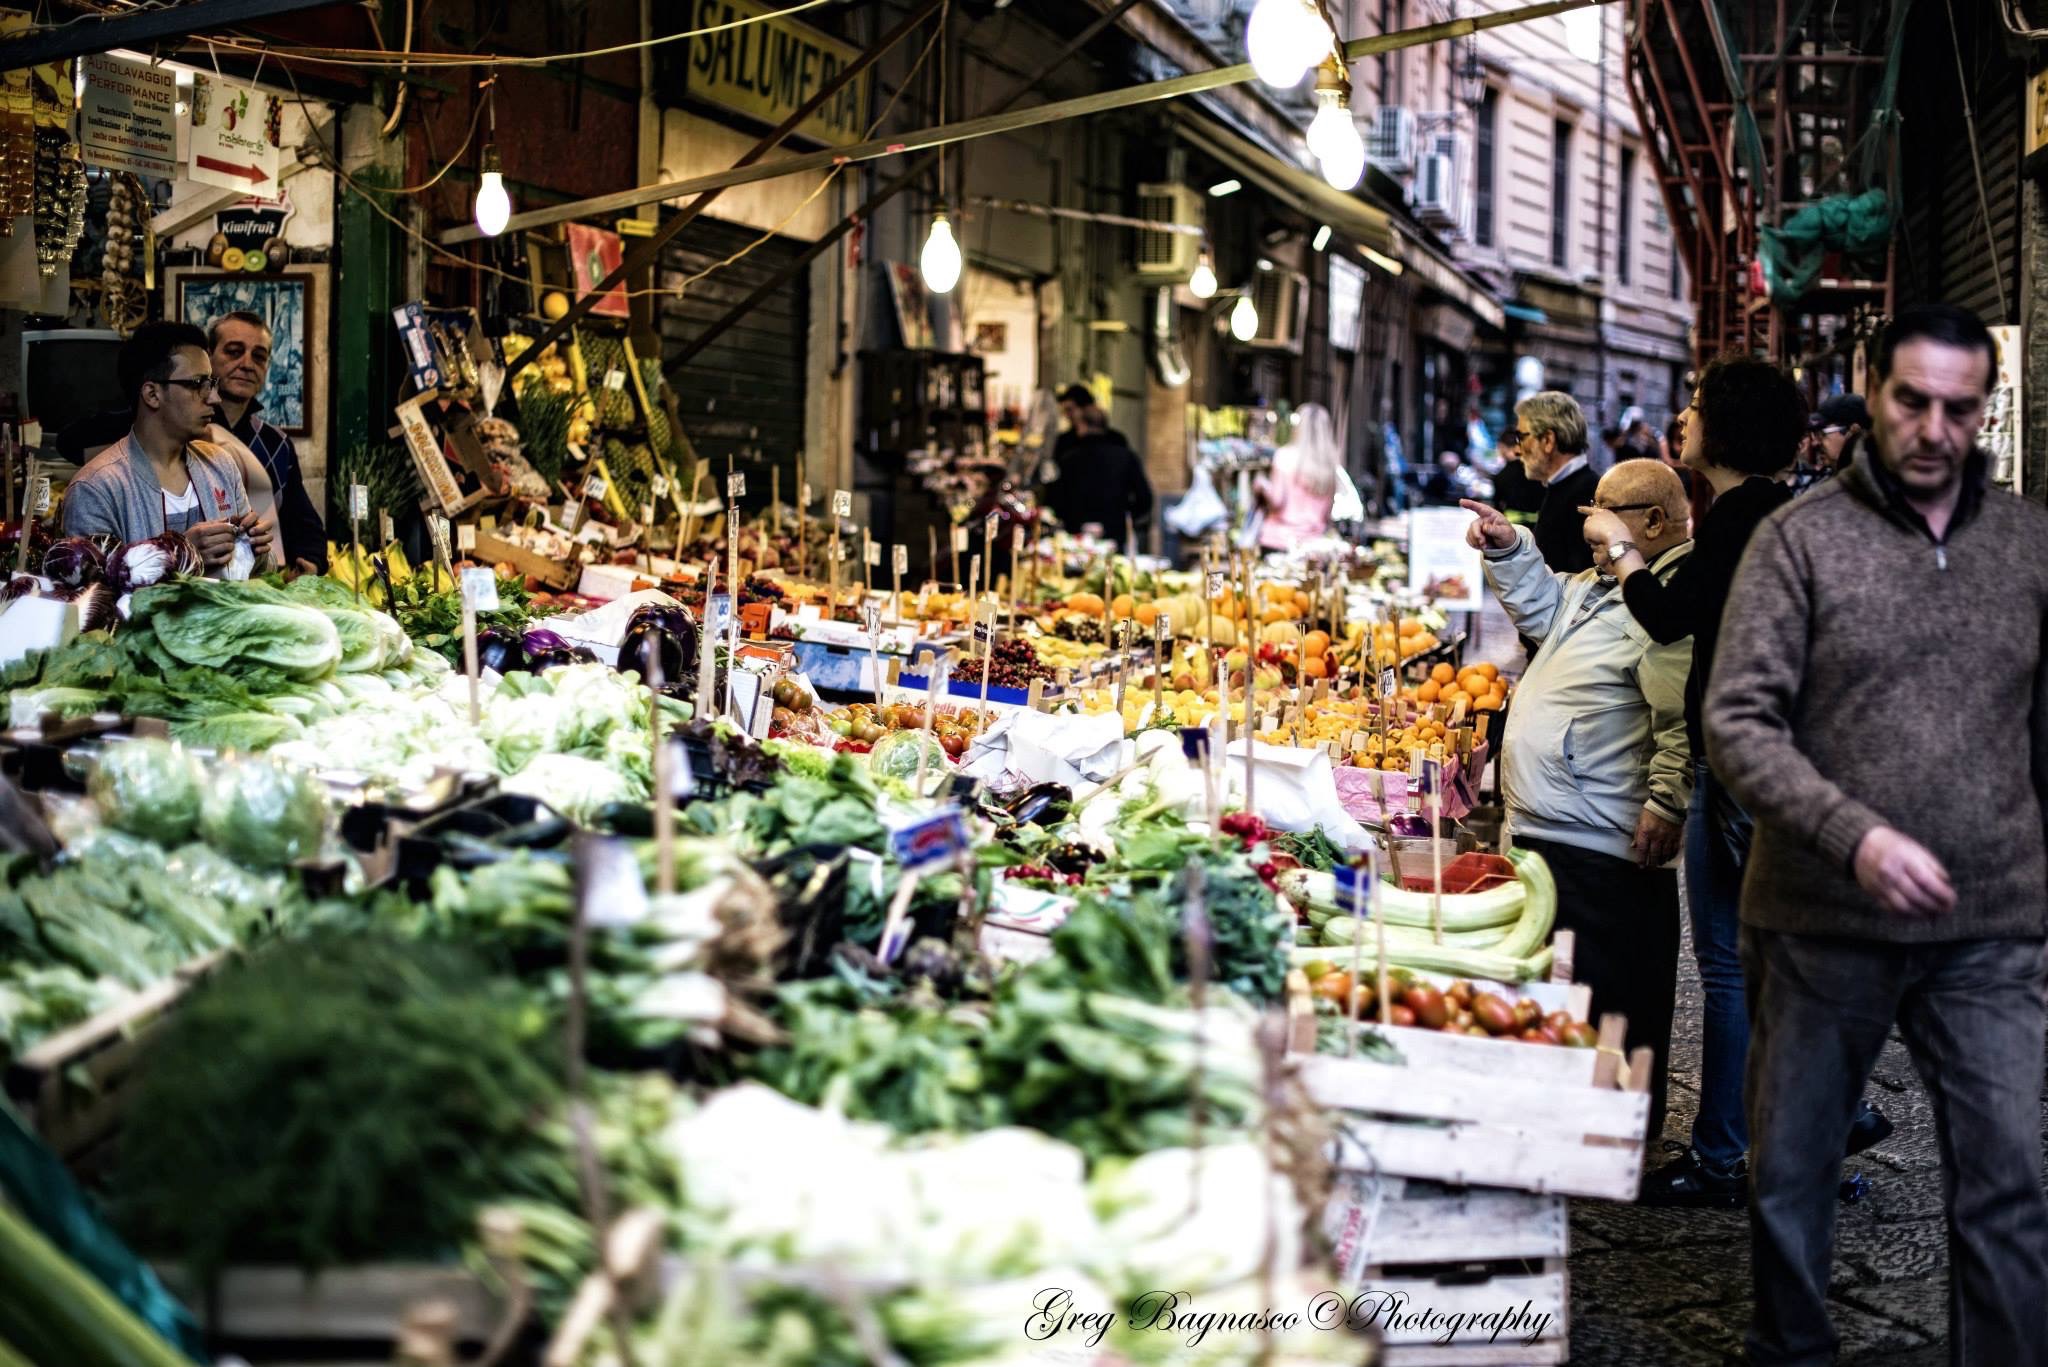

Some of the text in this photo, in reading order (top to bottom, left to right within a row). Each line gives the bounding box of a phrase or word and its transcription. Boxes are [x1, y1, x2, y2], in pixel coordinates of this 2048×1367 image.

[87, 57, 172, 87] AUTOLAVAGGIO
[693, 0, 859, 134] SALUMERIA
[88, 73, 171, 104] PERFORMANCE
[222, 220, 276, 237] Kiwifruit
